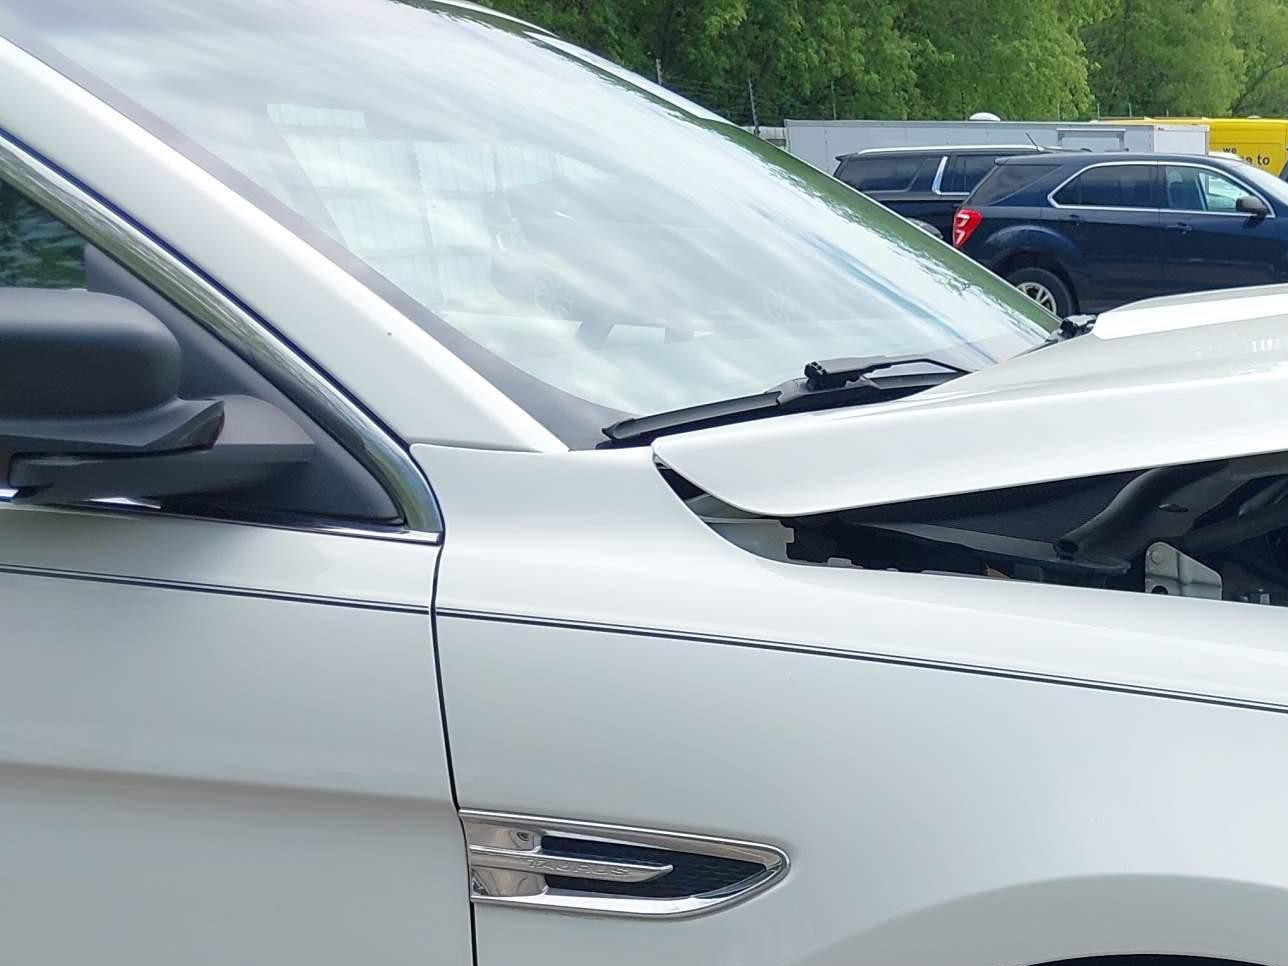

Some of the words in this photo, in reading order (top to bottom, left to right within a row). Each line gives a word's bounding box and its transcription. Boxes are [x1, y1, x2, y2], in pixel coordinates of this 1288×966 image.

[1222, 147, 1238, 155] we
[1257, 153, 1271, 166] to
[527, 858, 630, 877] TAURUS
